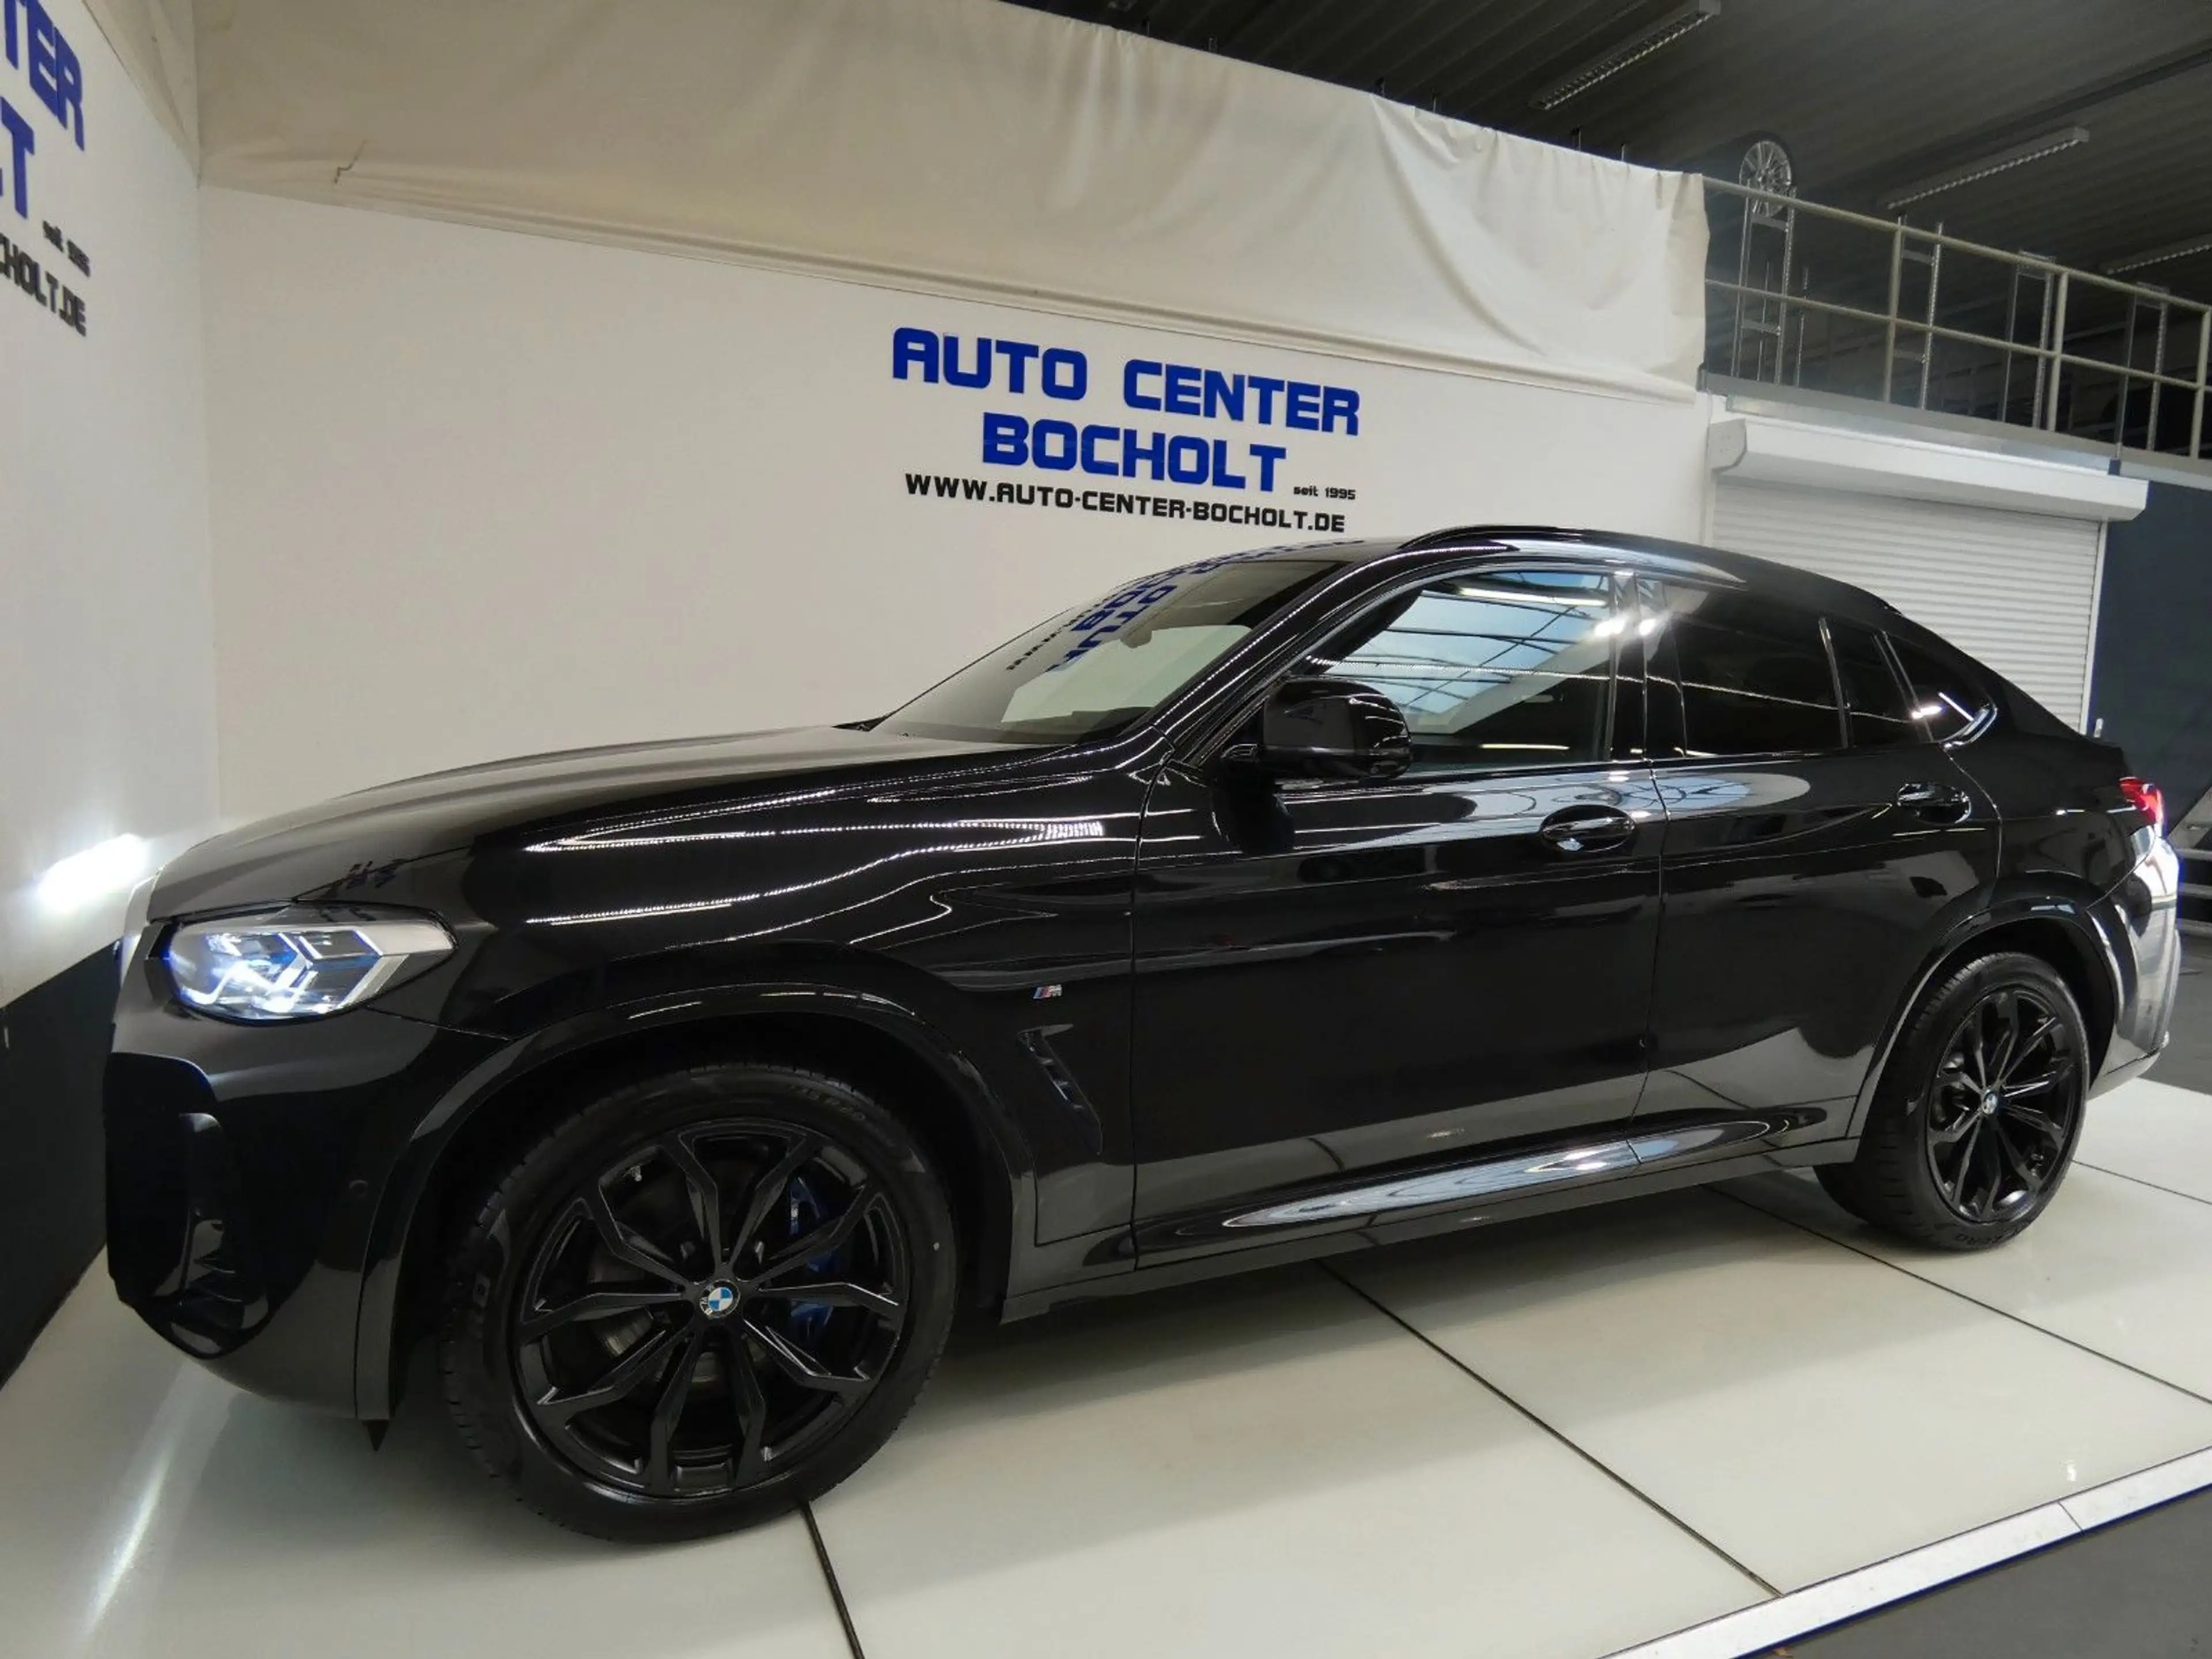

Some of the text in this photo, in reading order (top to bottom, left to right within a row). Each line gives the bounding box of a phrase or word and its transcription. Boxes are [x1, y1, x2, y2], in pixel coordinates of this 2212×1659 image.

[893, 327, 1360, 437] AUTO CENTER
[983, 411, 1287, 493] BOCHOLT
[906, 473, 1345, 533] WWW.AUTO-CENTER-BOCHOLT.DE
[1293, 485, 1356, 500] seit 1995
